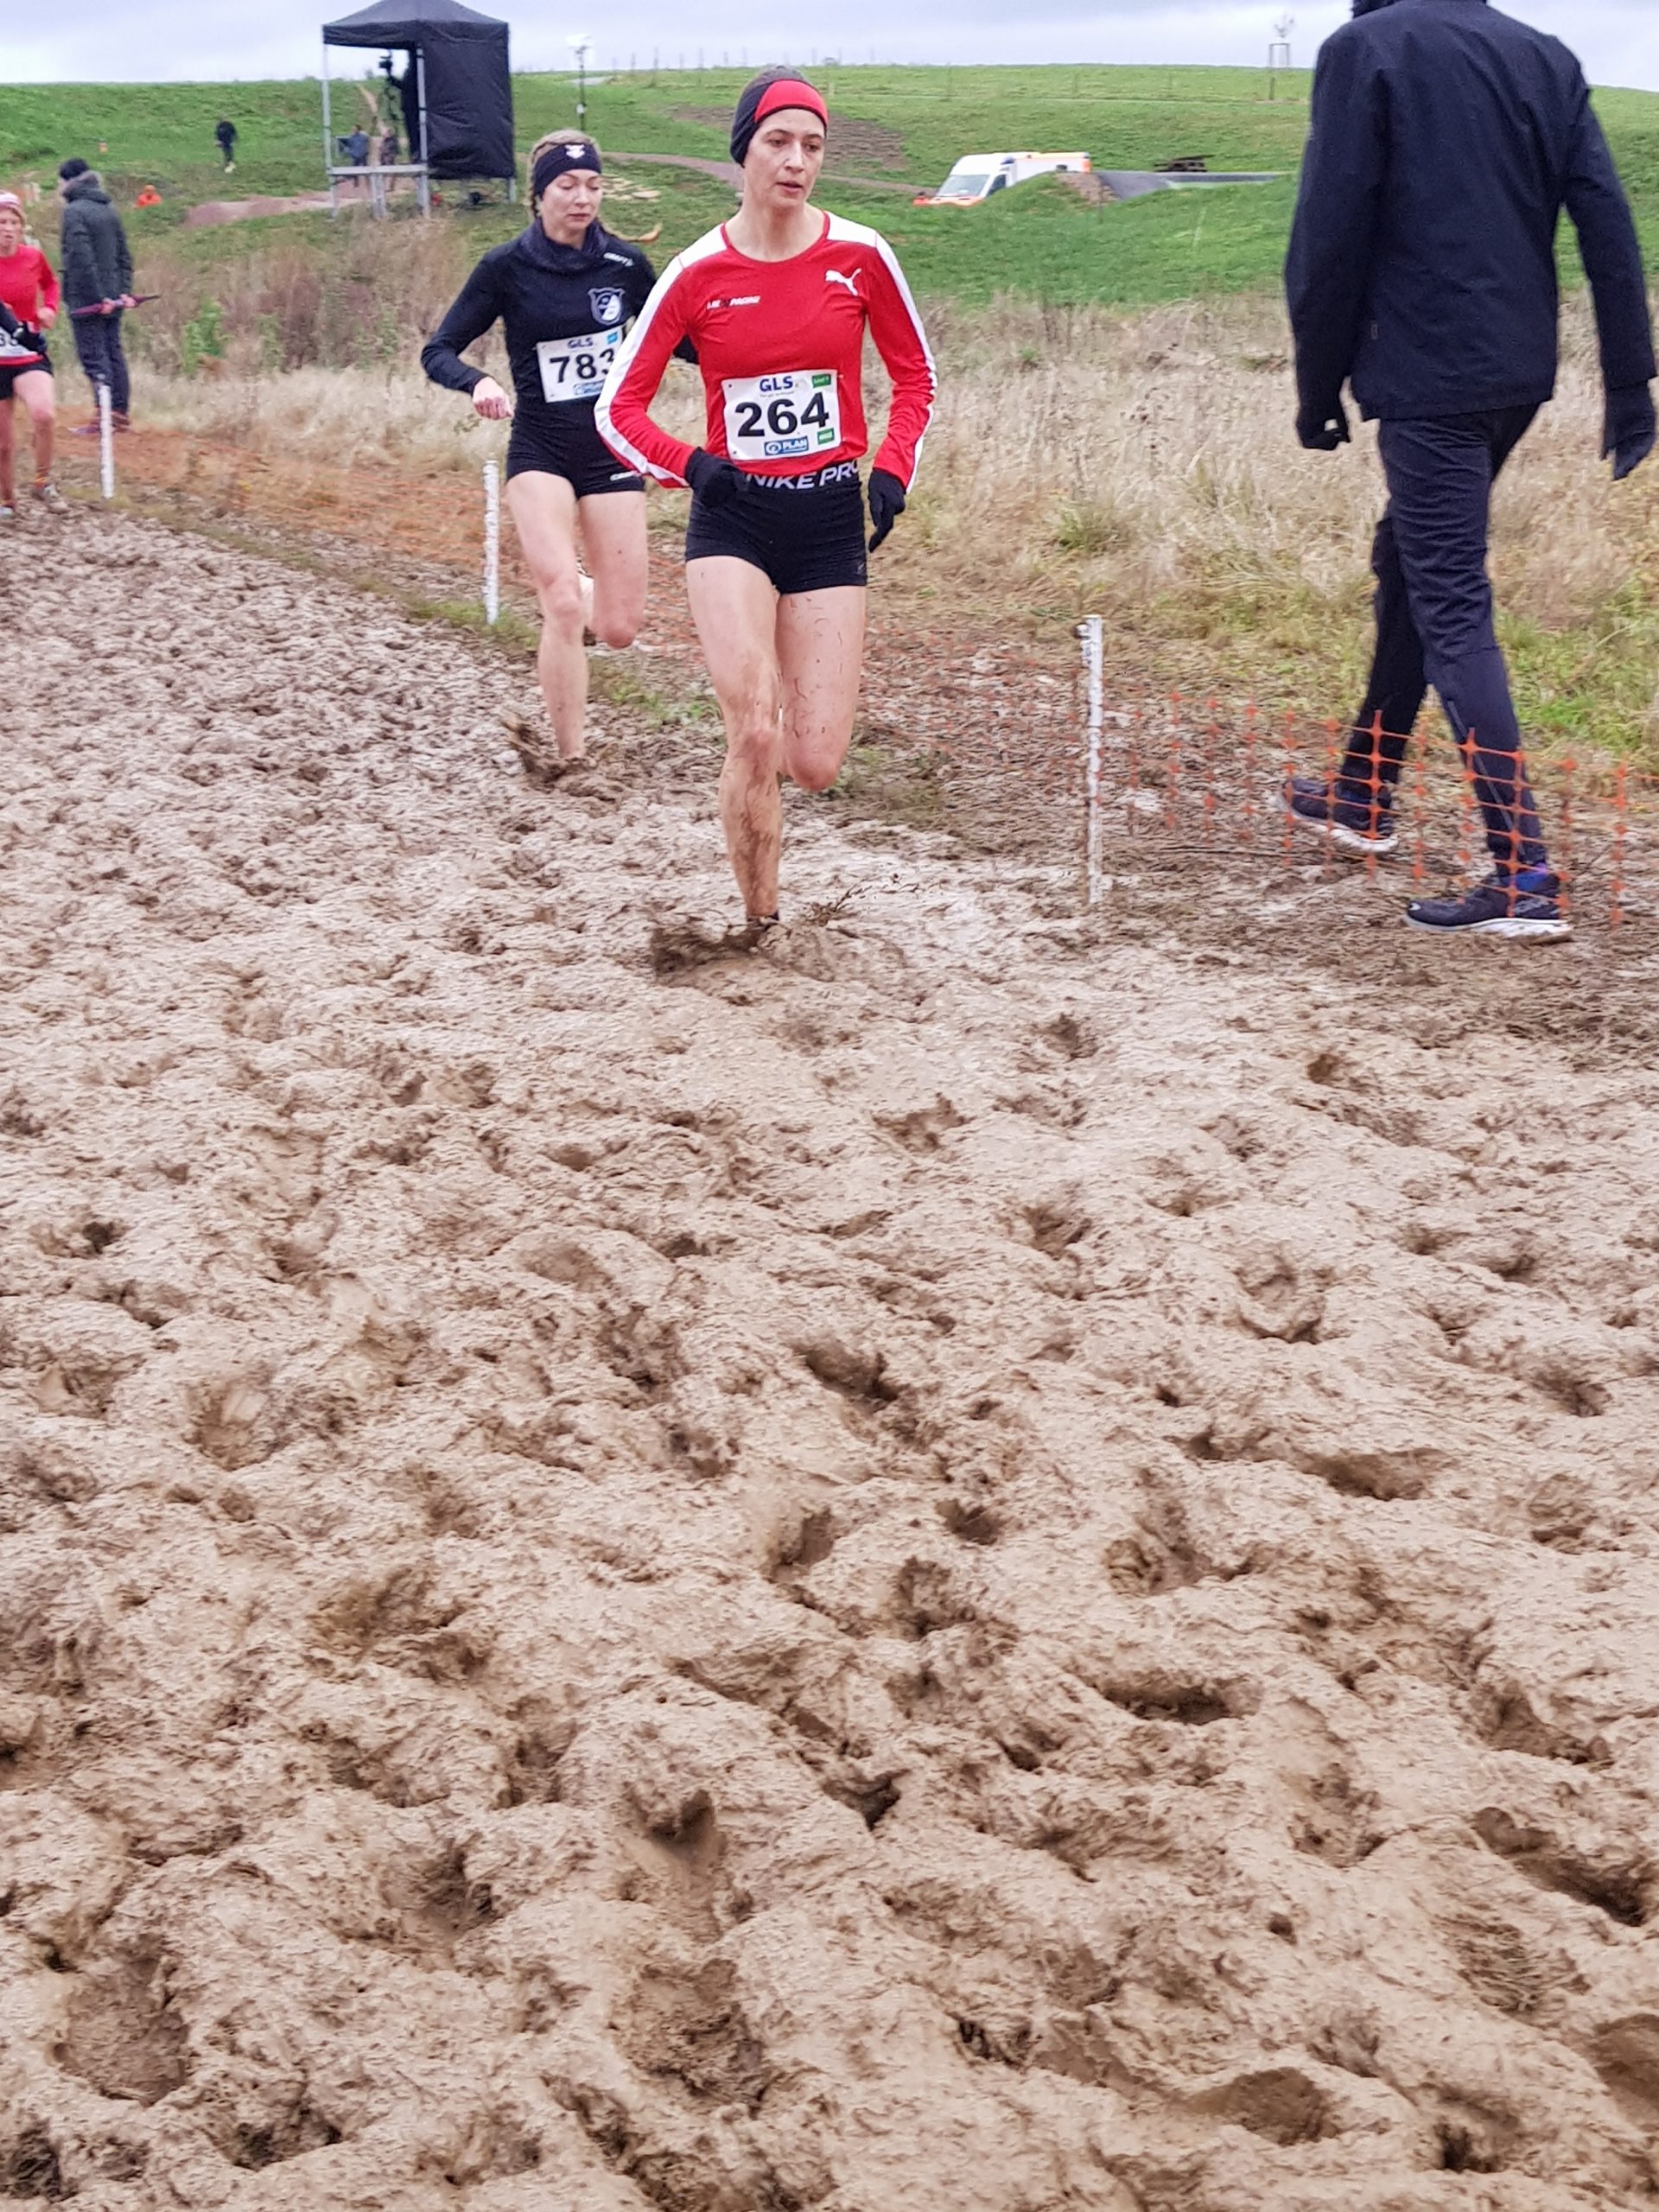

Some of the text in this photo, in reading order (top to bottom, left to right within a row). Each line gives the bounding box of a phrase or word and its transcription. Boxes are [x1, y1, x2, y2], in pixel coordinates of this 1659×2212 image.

[568, 337, 594, 349] GLS
[760, 375, 793, 392] GLS
[734, 391, 830, 437] 264
[746, 471, 817, 489] NIKE
